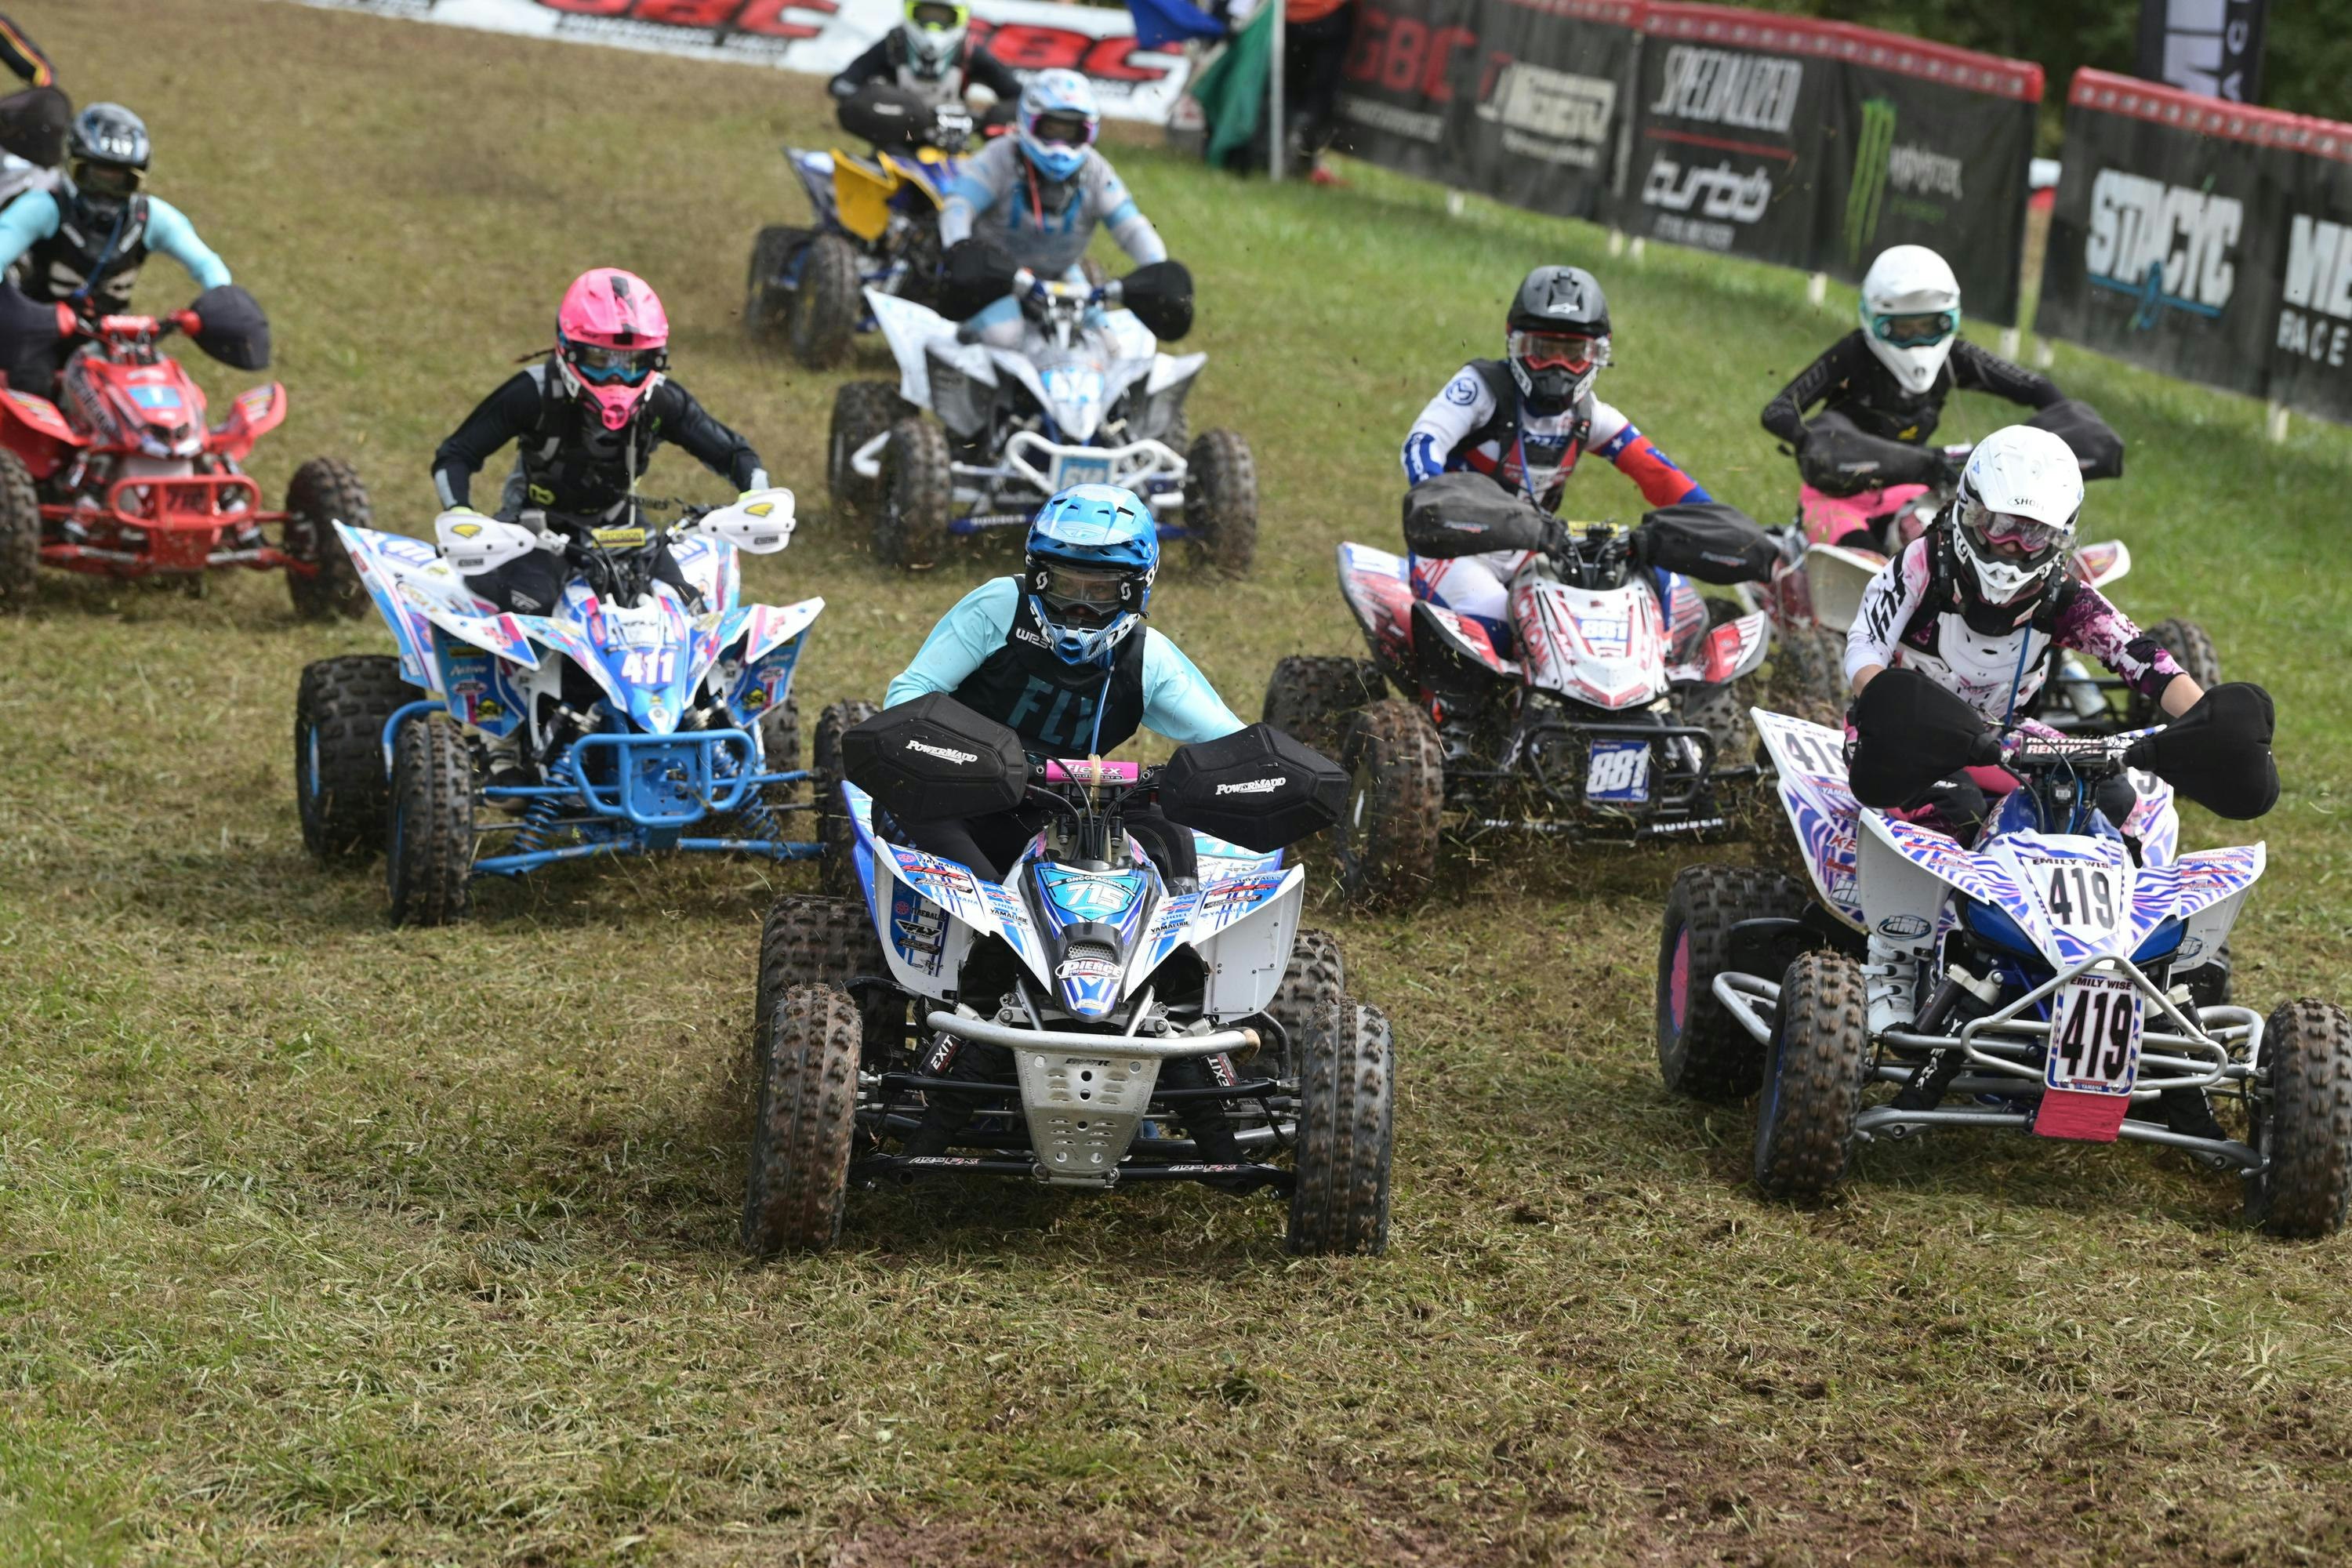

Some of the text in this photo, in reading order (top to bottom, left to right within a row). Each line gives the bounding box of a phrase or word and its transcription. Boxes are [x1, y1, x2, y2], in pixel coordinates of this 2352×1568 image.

[2085, 167, 2243, 309] STACYC
[2278, 309, 2350, 367] RACE
[621, 650, 675, 685] 411
[1006, 673, 1113, 750] FLY
[906, 739, 978, 764] POWERMADD
[1585, 744, 1650, 793] 881
[1215, 776, 1287, 795] POWERMADD
[1821, 786, 1857, 799] YAMAH
[2032, 857, 2077, 866] EMILY
[1066, 883, 1126, 910] 715
[2049, 867, 2115, 930] 419
[1061, 960, 1123, 977] PIERCE
[2070, 978, 2132, 991] EMILY WISE
[2060, 989, 2133, 1081] 419
[930, 1034, 953, 1070] EXIT
[1207, 1057, 1231, 1087] EXIT
